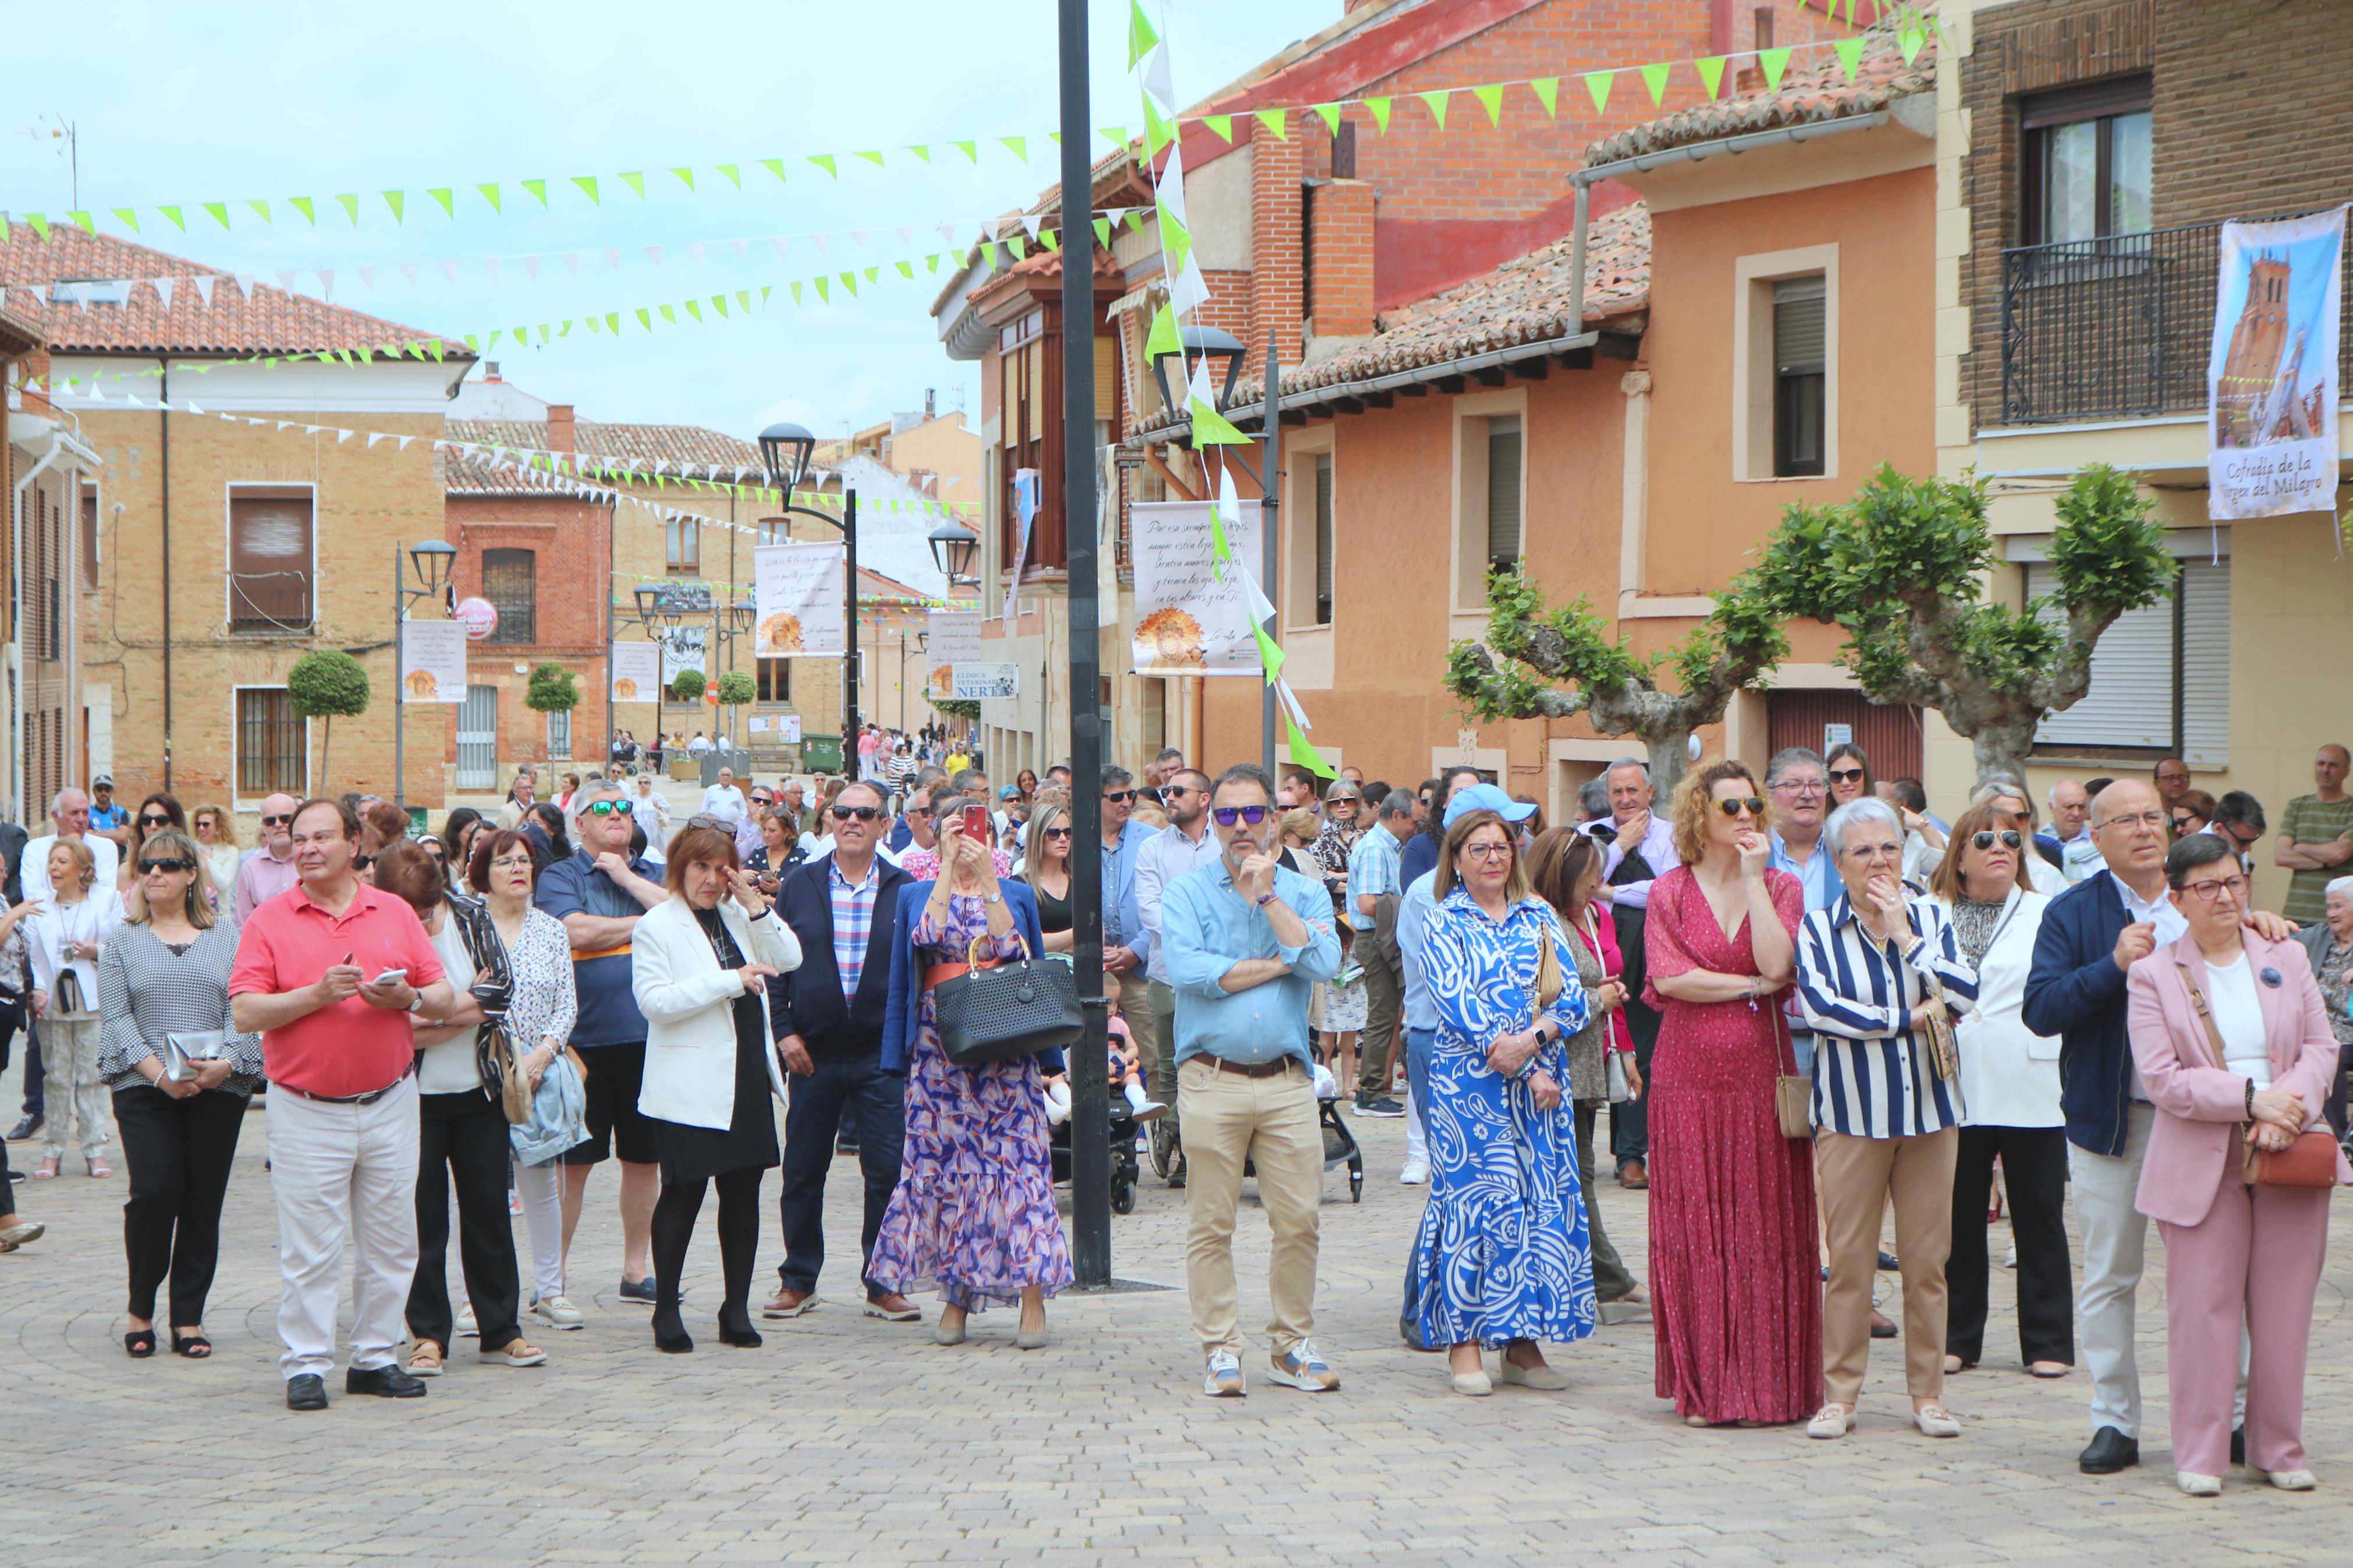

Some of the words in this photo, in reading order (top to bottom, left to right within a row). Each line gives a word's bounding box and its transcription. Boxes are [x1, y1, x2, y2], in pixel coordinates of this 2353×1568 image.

[2227, 457, 2274, 482] Cofradía
[2279, 453, 2294, 473] de
[2298, 451, 2311, 471] la
[2253, 476, 2269, 496] del
[2274, 472, 2322, 497] Milagro
[1147, 520, 1166, 534] Por
[1182, 522, 1211, 534] siempre
[1148, 542, 1173, 559] aunque
[1154, 558, 1182, 568] sienten
[1184, 559, 1208, 568] amores
[1152, 579, 1160, 592] y
[1163, 576, 1187, 585] tienen
[1189, 572, 1198, 585] los
[1166, 592, 1177, 603] tus
[1180, 590, 1205, 602] altares
[1205, 594, 1213, 607] y
